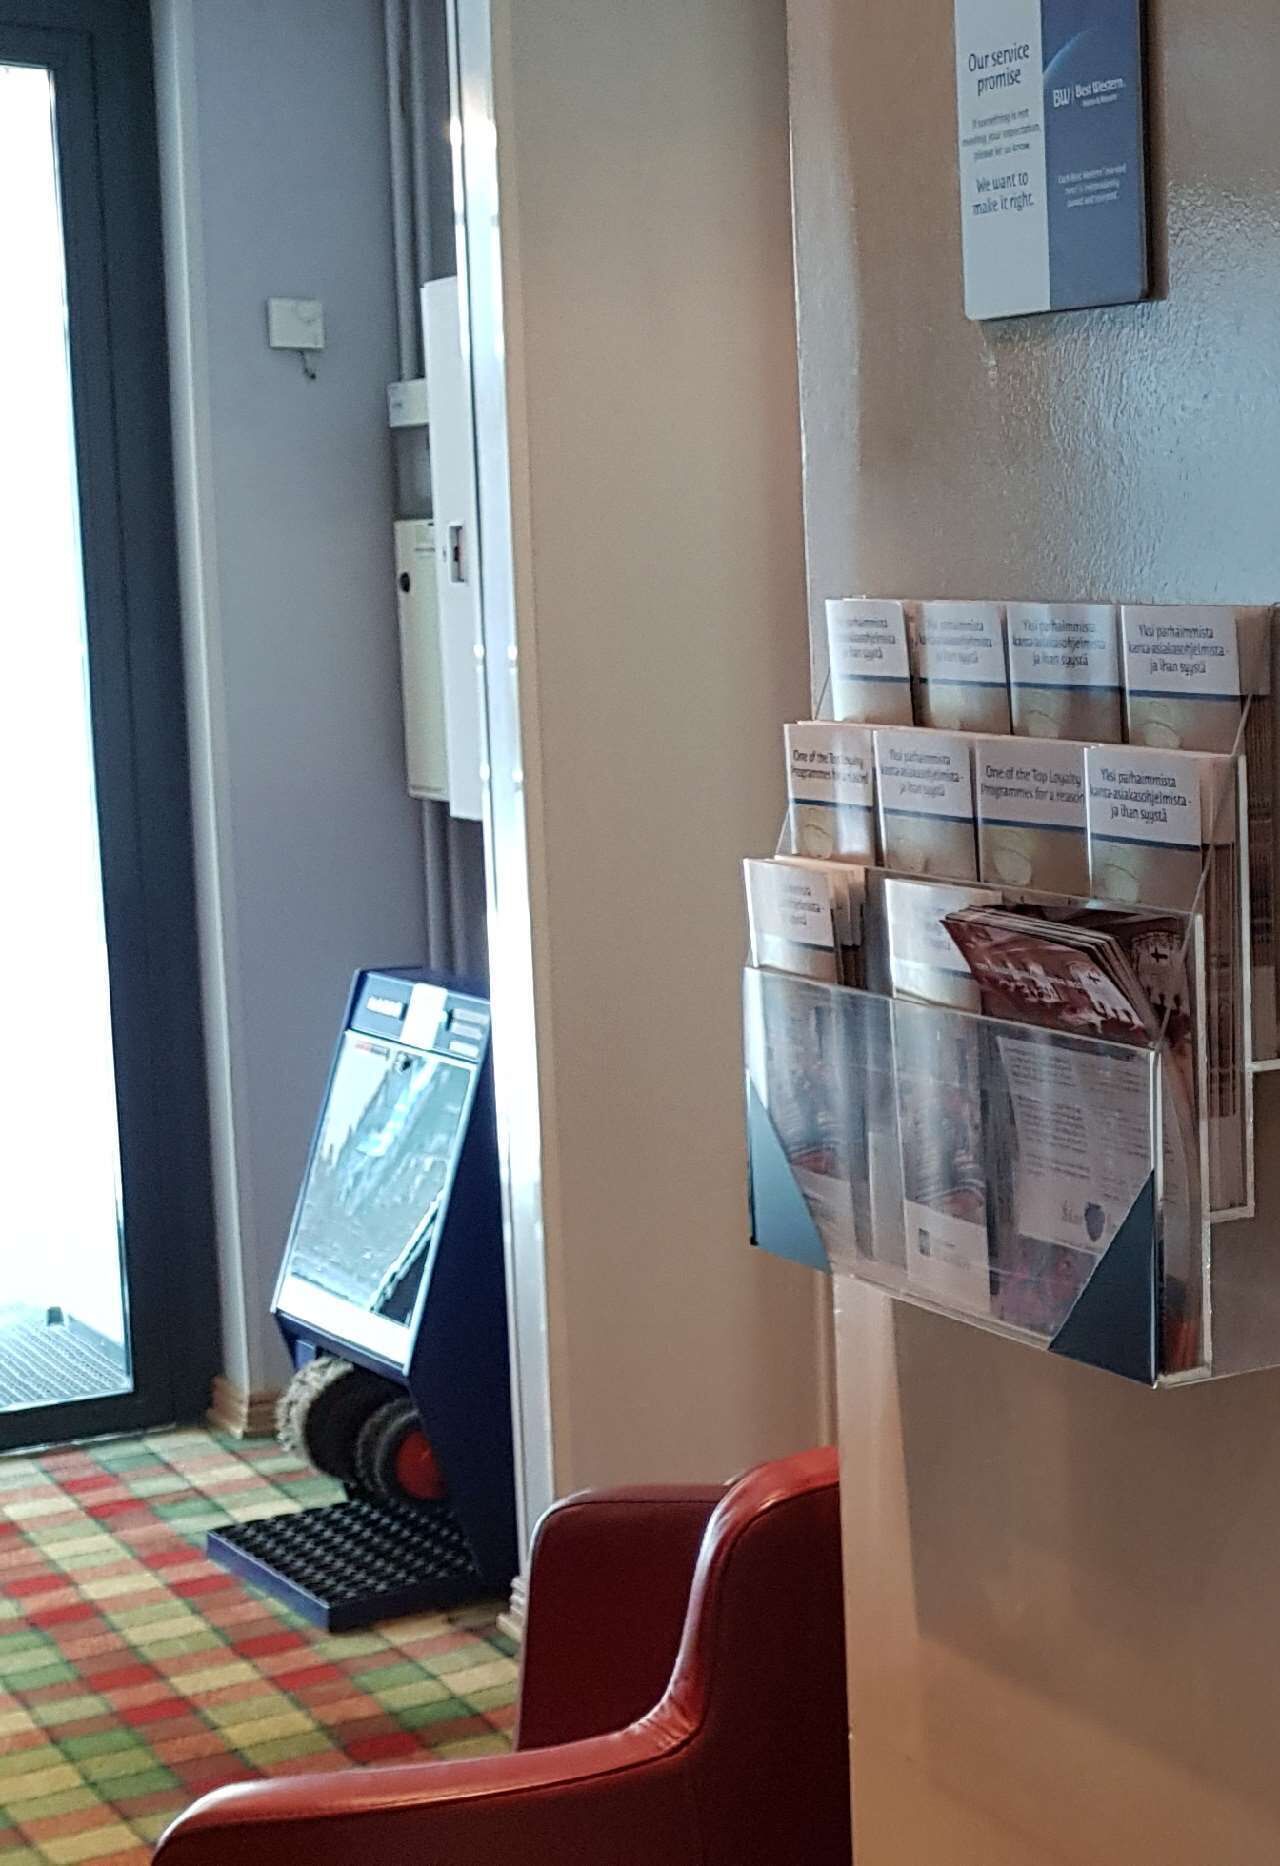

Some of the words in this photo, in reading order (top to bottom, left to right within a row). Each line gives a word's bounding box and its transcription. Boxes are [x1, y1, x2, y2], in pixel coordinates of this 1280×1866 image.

[968, 53, 989, 72] Our
[991, 43, 1030, 66] service
[977, 67, 1021, 96] promise
[1053, 88, 1071, 108] BW
[1075, 83, 1091, 98] Best
[976, 177, 991, 193] We
[992, 174, 1016, 190] want
[1018, 172, 1029, 187] to
[972, 199, 998, 215] make
[1000, 195, 1008, 210] it
[1040, 620, 1096, 635] parhaimmista
[1138, 624, 1154, 637] Yksi
[1156, 624, 1214, 641] parhaimmista
[1150, 659, 1158, 674] ja
[1159, 658, 1178, 672] ihan
[1179, 661, 1207, 676] syystä
[793, 750, 808, 764] One
[985, 765, 1003, 779] One
[1005, 766, 1013, 780] of
[1015, 767, 1031, 780] the
[1032, 768, 1048, 784] Top
[1050, 769, 1082, 787] Loyalty
[1100, 768, 1116, 781] Yksi
[1118, 771, 1176, 788] parhaimmista
[981, 784, 1033, 800] Programmes
[1035, 786, 1048, 799] for
[1049, 790, 1055, 801] a
[1056, 790, 1086, 805] reason
[1111, 806, 1119, 819] ja
[1120, 804, 1139, 819] ihan
[1140, 808, 1168, 824] syystä
